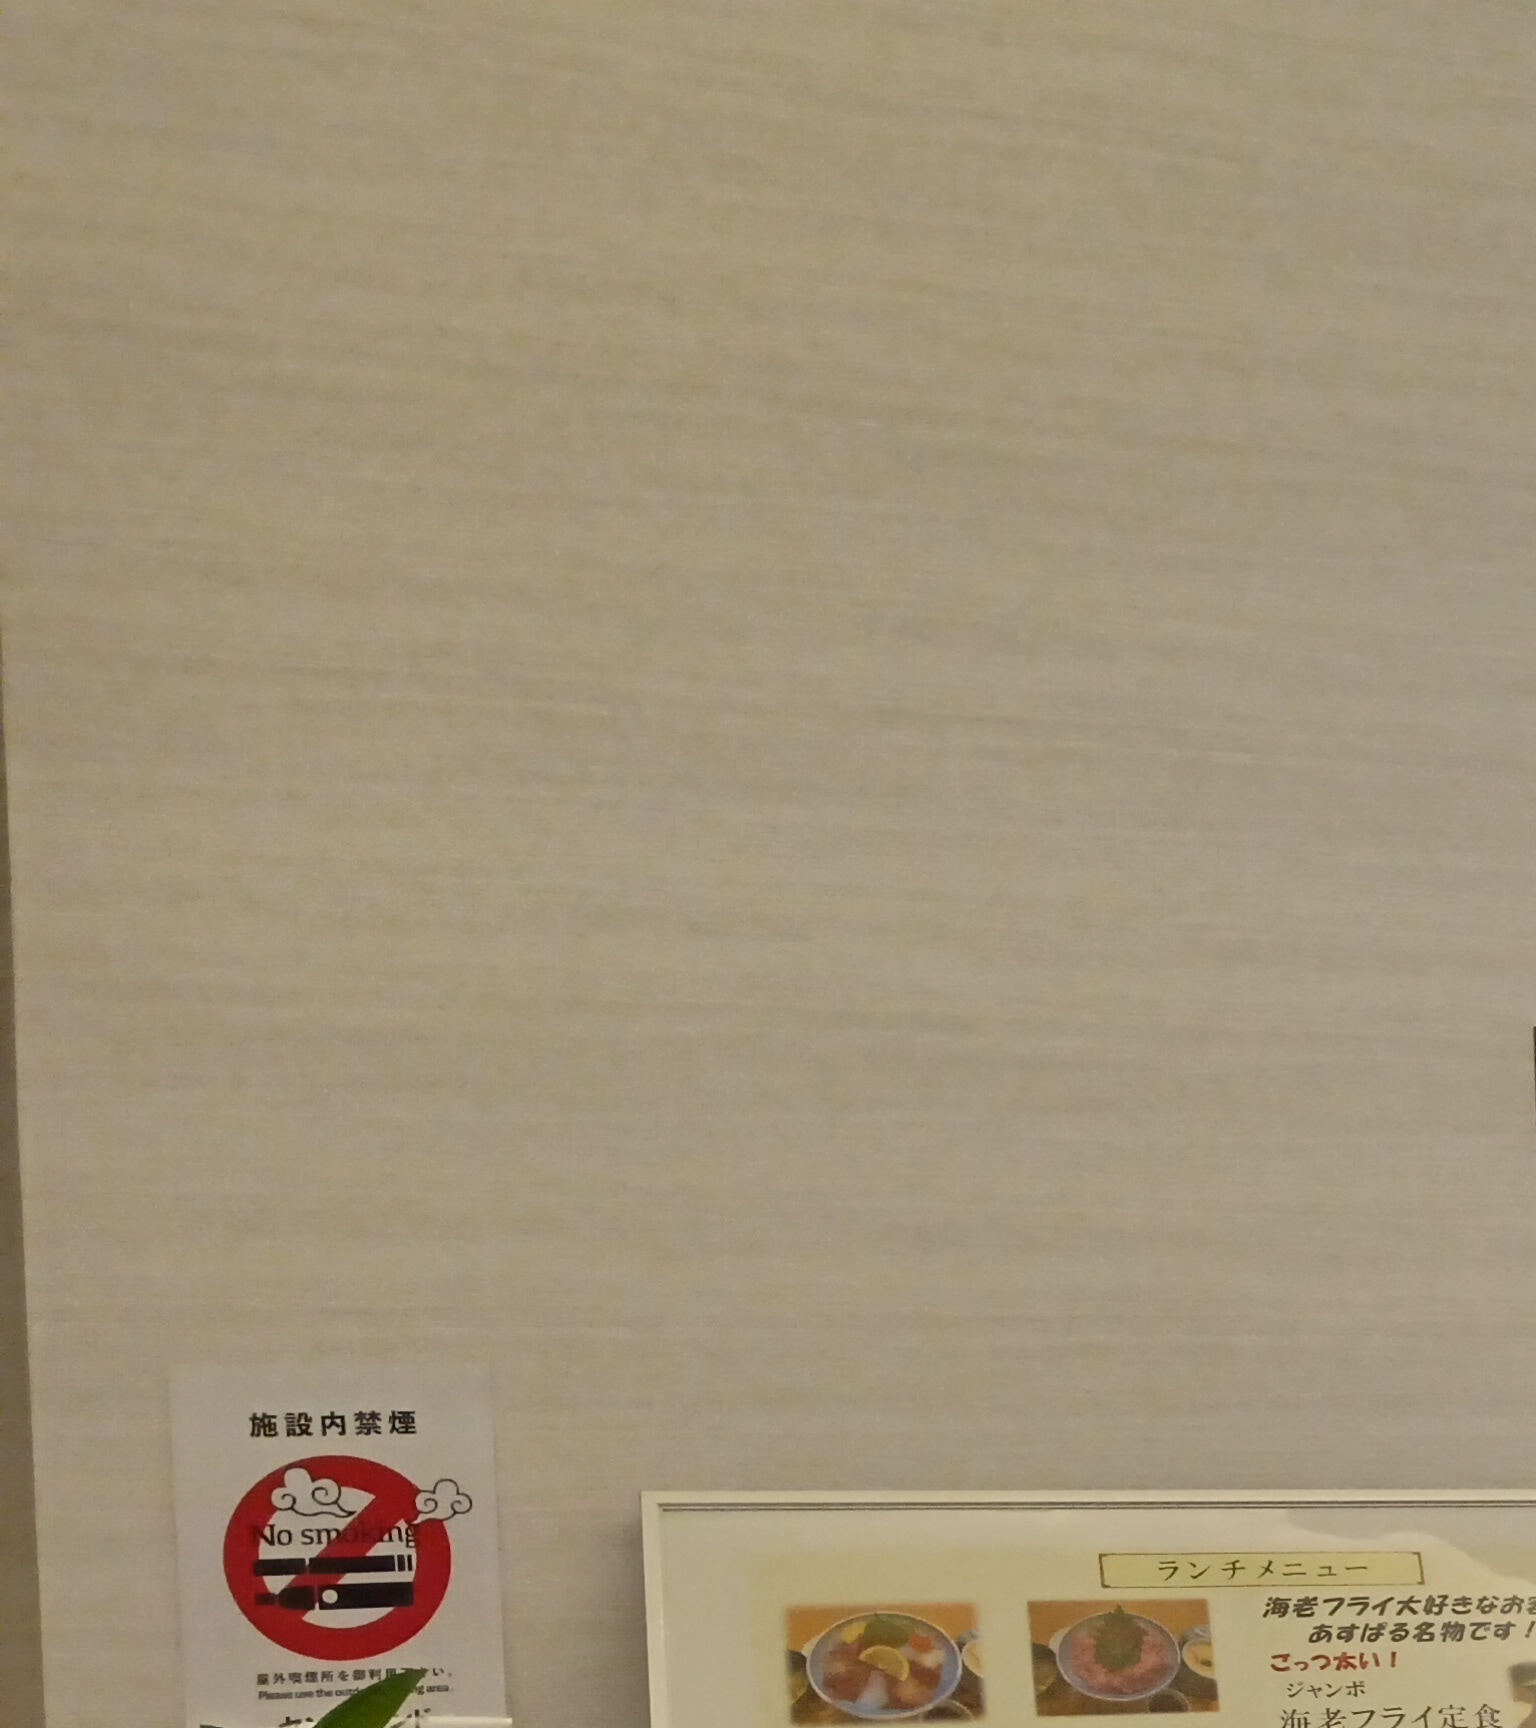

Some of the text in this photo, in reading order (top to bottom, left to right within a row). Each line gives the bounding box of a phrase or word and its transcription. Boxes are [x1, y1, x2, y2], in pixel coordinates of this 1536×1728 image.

[249, 1411, 417, 1438] 施設内禁煙
[252, 1524, 292, 1546] No
[1158, 1560, 1368, 1581] ランチメニュー
[316, 1688, 333, 1698] the
[1286, 1681, 1366, 1699] ジャンボ
